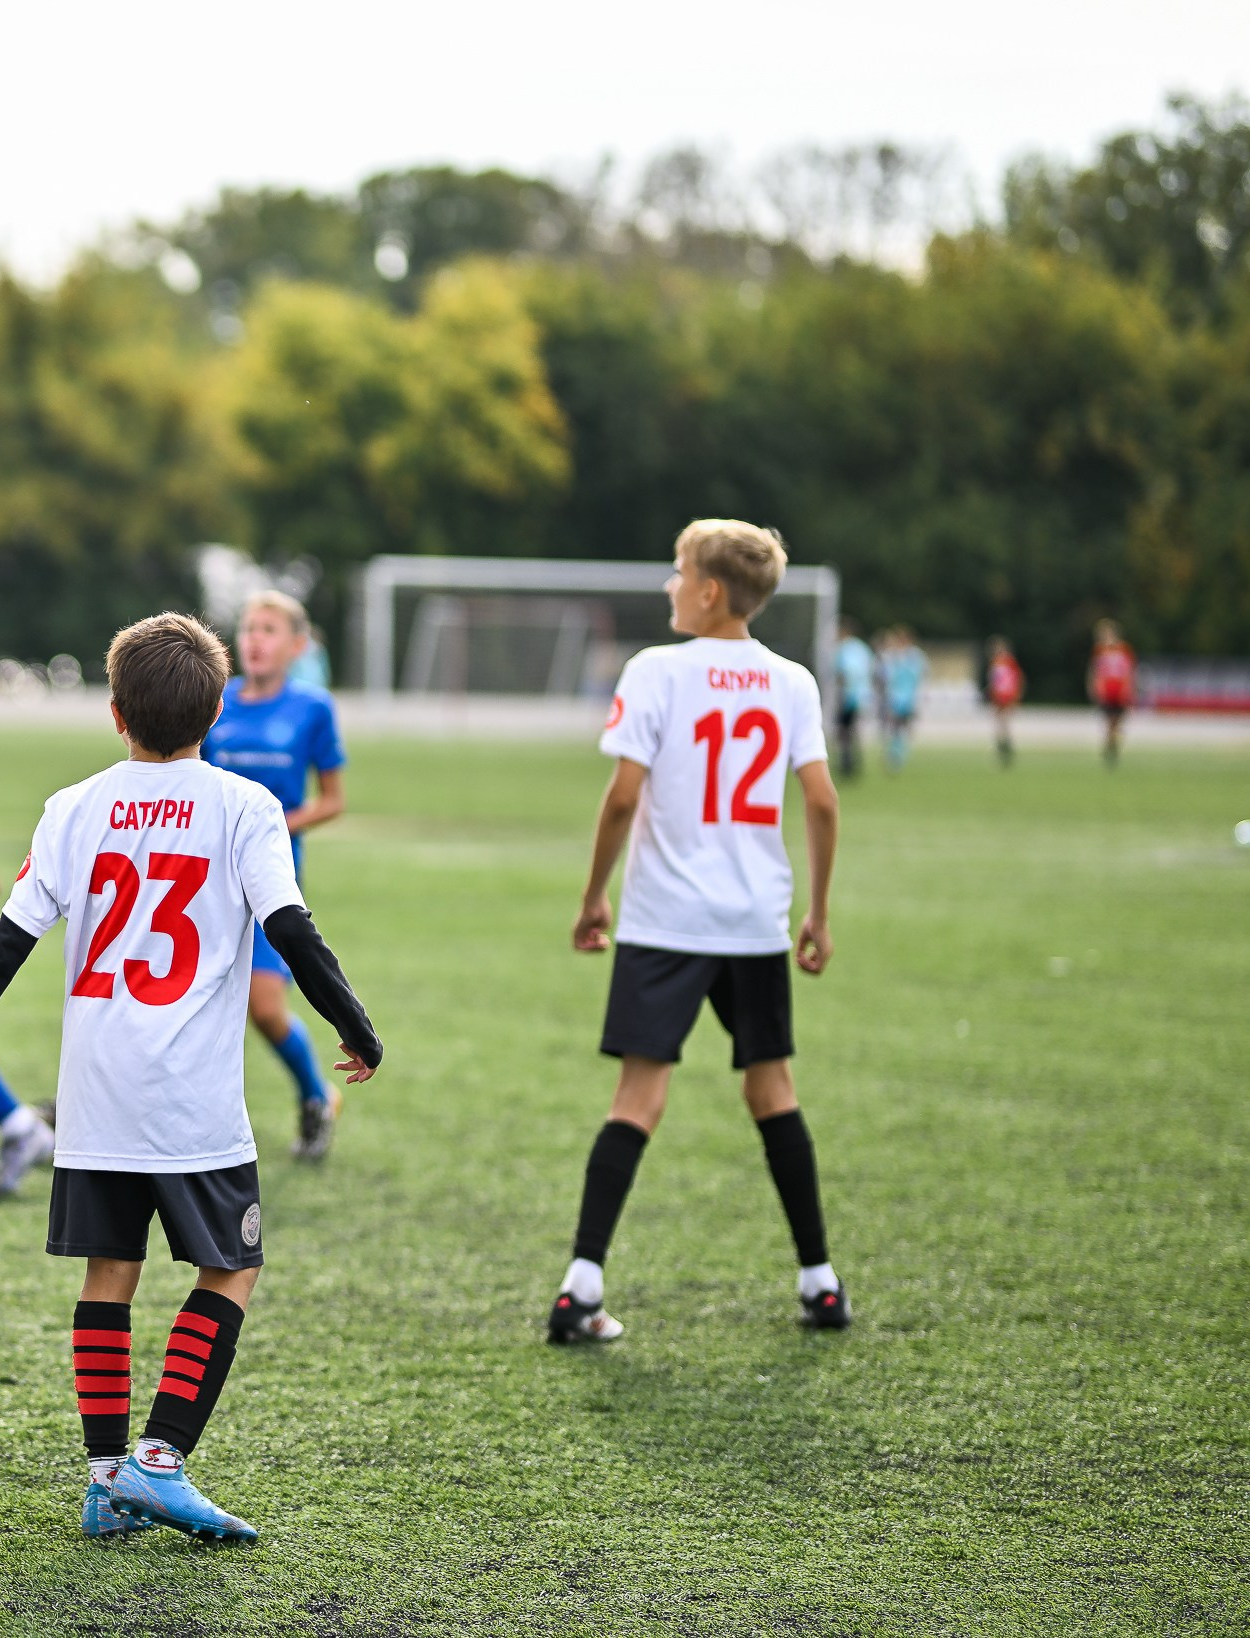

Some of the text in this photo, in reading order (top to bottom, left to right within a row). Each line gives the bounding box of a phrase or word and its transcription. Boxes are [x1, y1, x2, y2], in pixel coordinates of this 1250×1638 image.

[708, 667, 770, 690] САТУРН
[694, 708, 781, 826] 12
[110, 799, 194, 830] САТУРН
[70, 852, 210, 1006] 23
